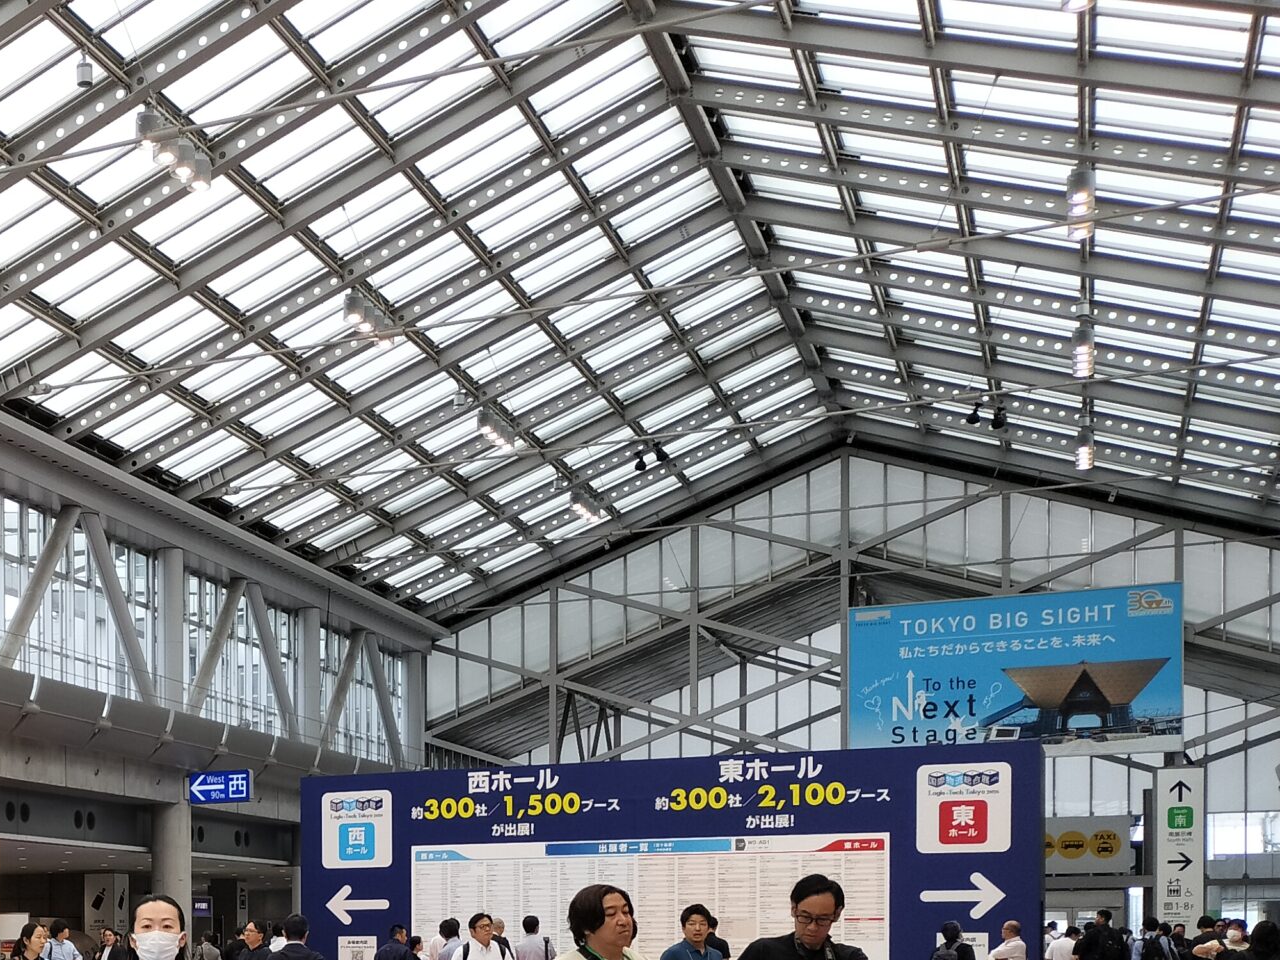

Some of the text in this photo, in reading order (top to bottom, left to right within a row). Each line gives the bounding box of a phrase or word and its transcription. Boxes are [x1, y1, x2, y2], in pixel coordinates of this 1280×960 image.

[899, 604, 1116, 636] TOKYO BIG SIGHT
[899, 633, 1116, 659] 私たちだからできることを、未来へ
[922, 676, 977, 692] To the
[891, 693, 977, 722] Next
[891, 726, 977, 745] Stage
[718, 756, 823, 783] 東ホール
[206, 775, 225, 784] West
[228, 774, 247, 798] 西
[467, 768, 560, 794] 西ホール
[210, 791, 226, 800] 90m
[951, 804, 975, 826] 東
[1174, 814, 1187, 827] 南
[348, 826, 366, 845] 西
[948, 828, 978, 837] ホール
[346, 847, 368, 855] ホール
